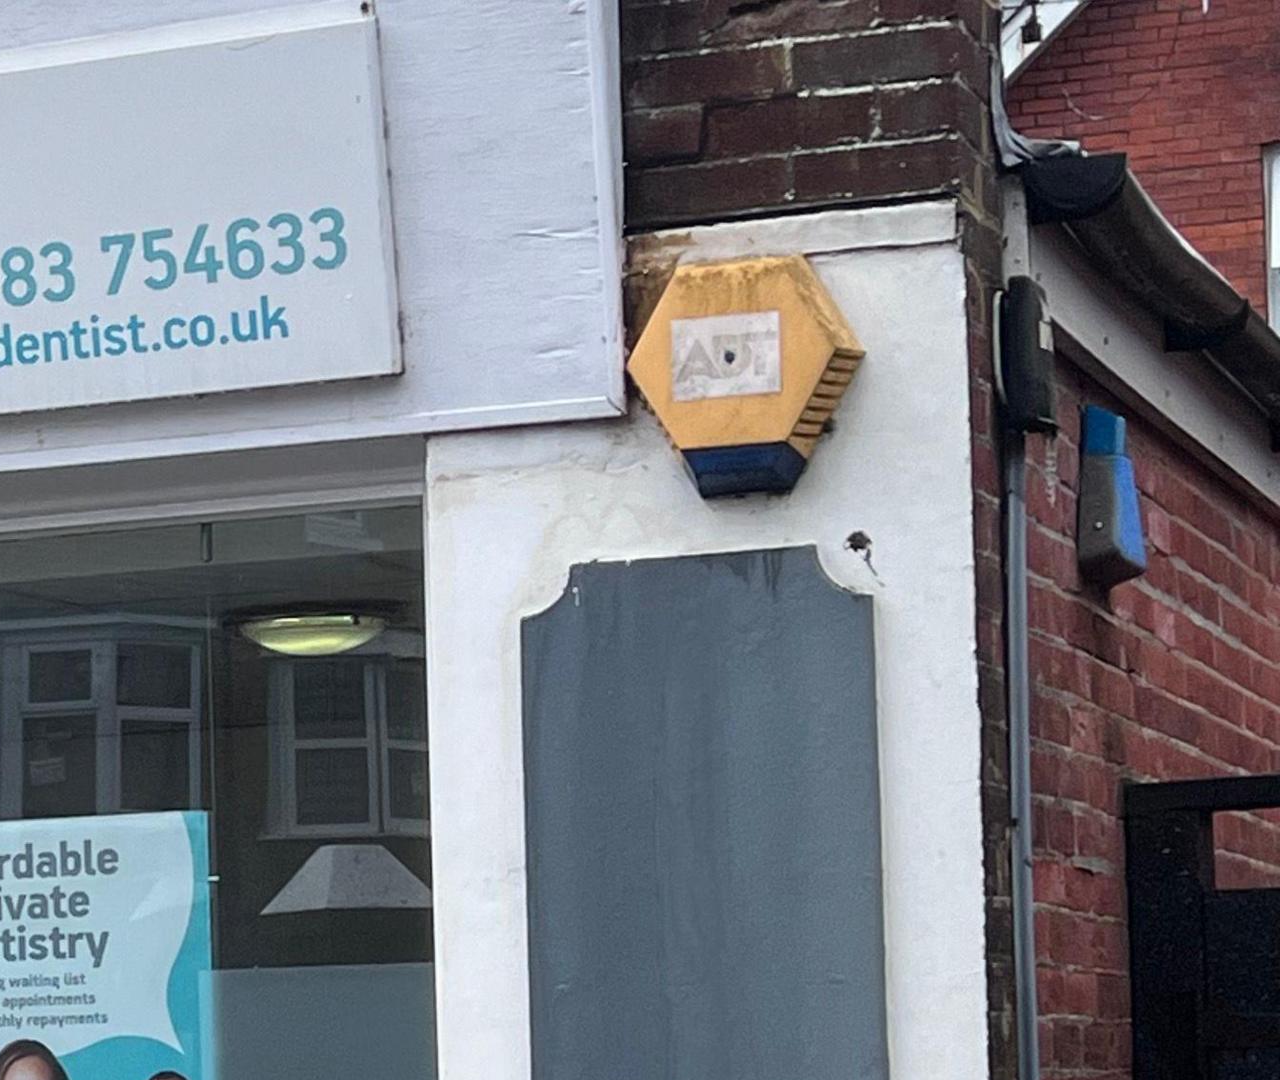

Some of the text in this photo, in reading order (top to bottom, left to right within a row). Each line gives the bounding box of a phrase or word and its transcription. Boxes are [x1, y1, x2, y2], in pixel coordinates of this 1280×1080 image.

[100, 207, 349, 297] 754633
[8, 974, 61, 990] waiting
[63, 972, 87, 987] list
[2, 991, 97, 1010] appointments
[26, 1012, 109, 1029] repayments
